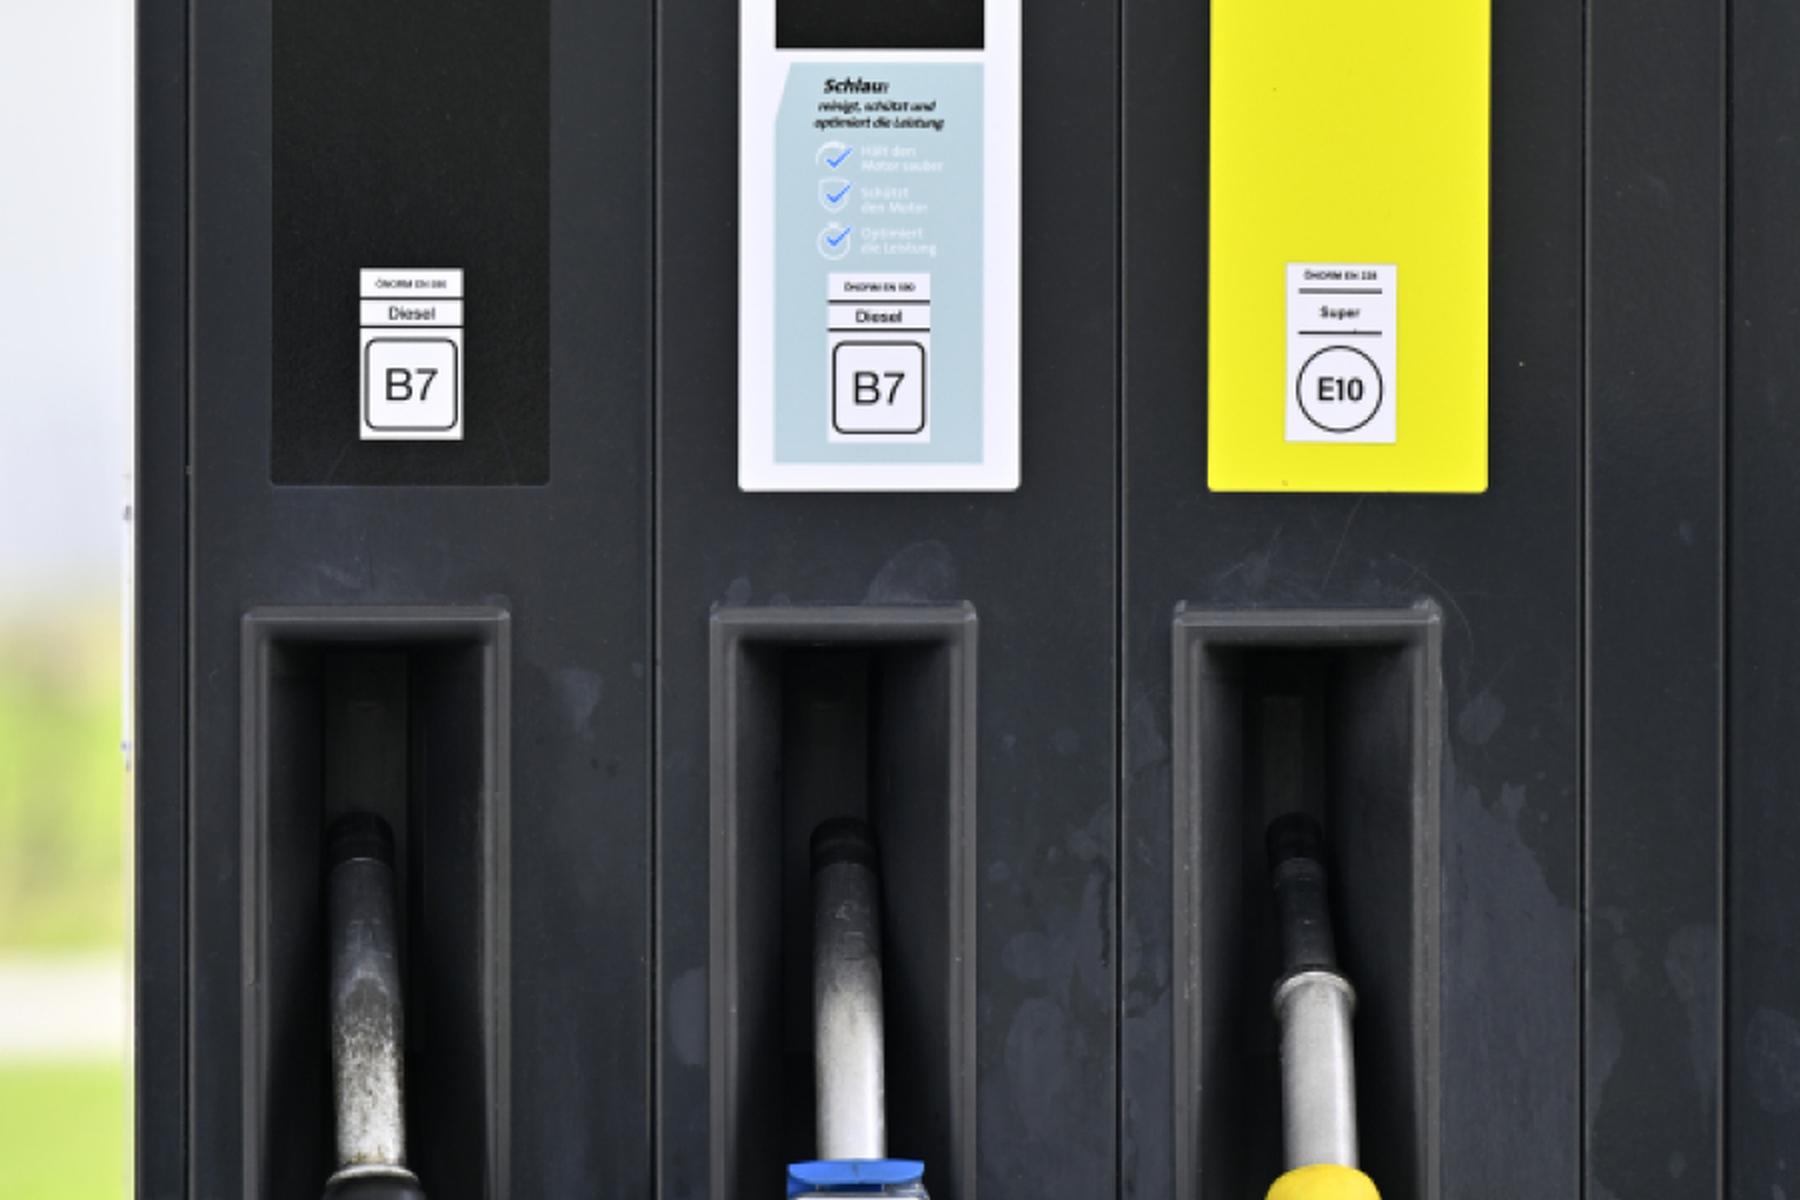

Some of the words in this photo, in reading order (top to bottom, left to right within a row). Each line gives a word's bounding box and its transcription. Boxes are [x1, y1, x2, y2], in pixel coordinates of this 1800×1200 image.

[910, 100, 936, 112] und
[814, 117, 871, 131] optimiert
[872, 117, 891, 129] die
[893, 117, 944, 132] Leistung
[861, 202, 885, 215] den
[861, 242, 881, 255] die
[388, 305, 436, 321] Diesel
[855, 308, 903, 323] Diesel
[1319, 304, 1360, 321] Super
[385, 367, 439, 401] B7
[854, 370, 905, 406] B7
[1317, 376, 1364, 402] E10
